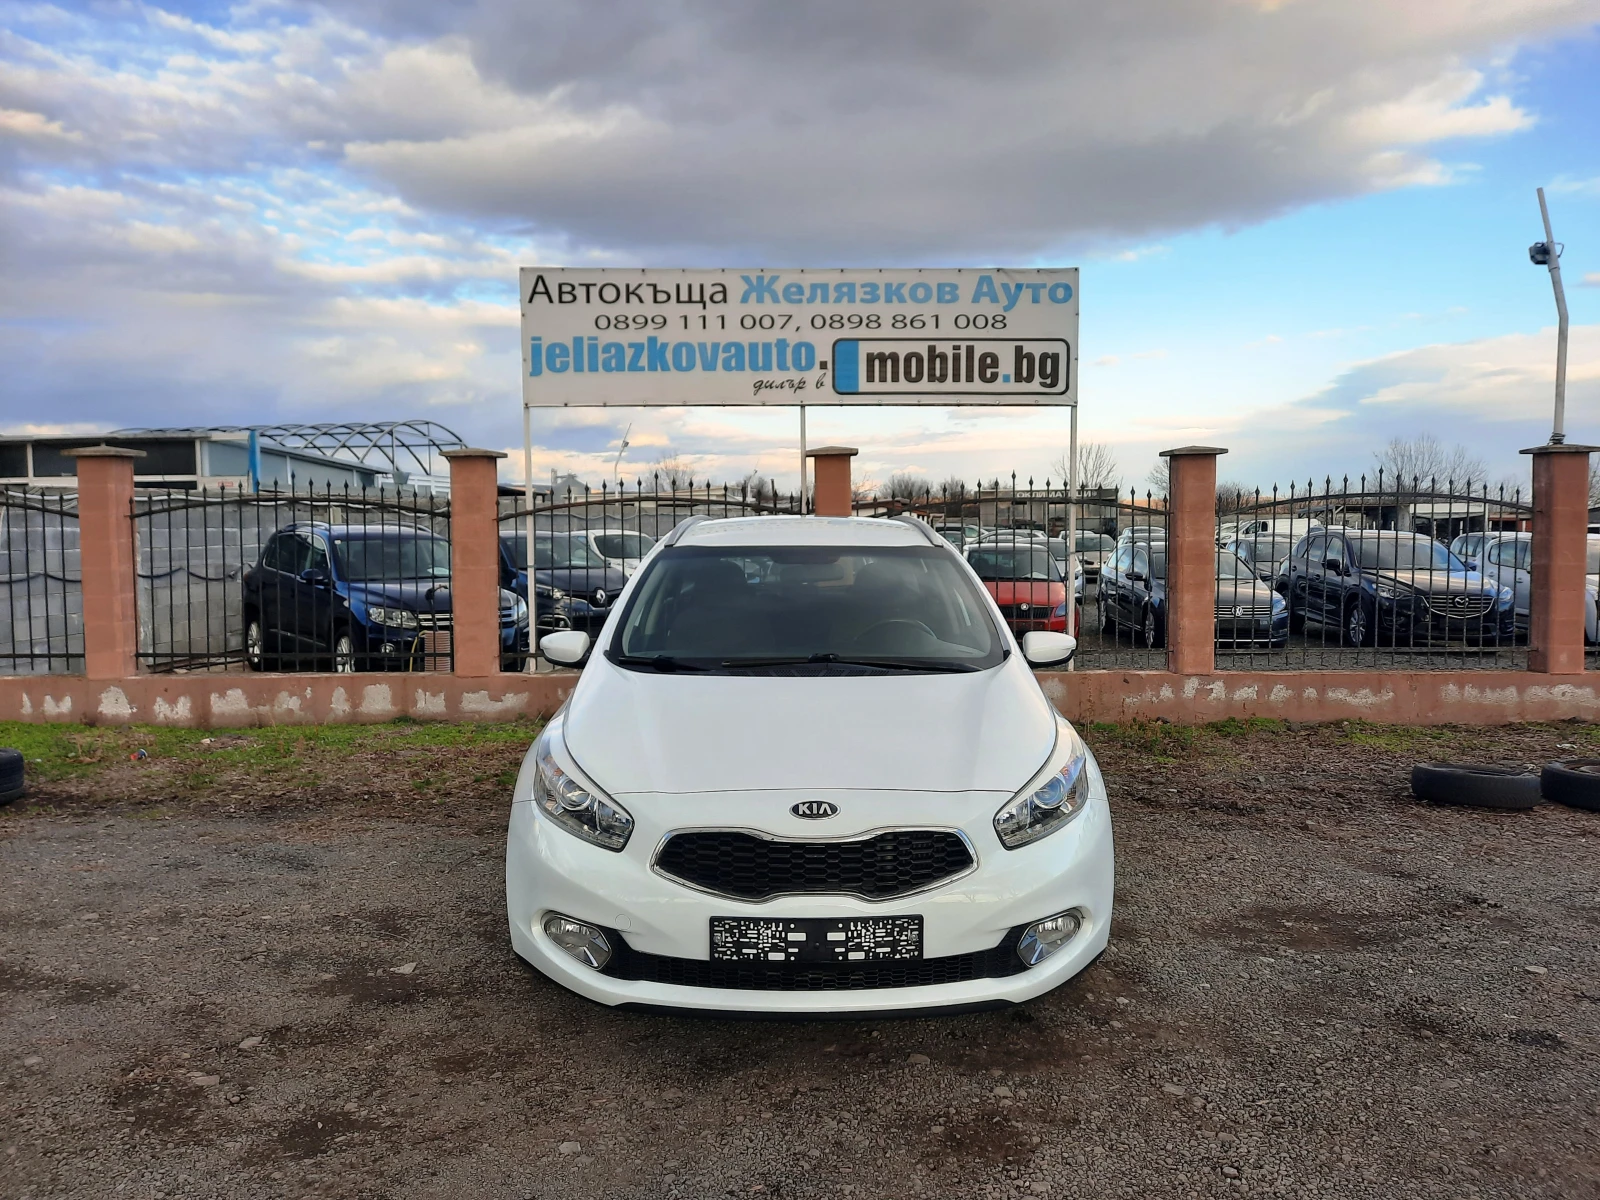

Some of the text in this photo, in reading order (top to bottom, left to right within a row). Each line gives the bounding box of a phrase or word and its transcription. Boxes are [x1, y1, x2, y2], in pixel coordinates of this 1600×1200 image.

[527, 274, 1073, 313] Автокъща Желязков Ауто
[594, 314, 1007, 332] 0899 111 007, 0898 861 008
[866, 345, 1060, 388] mobile.bg
[753, 377, 807, 395] дилър
[798, 803, 833, 815] KIA
